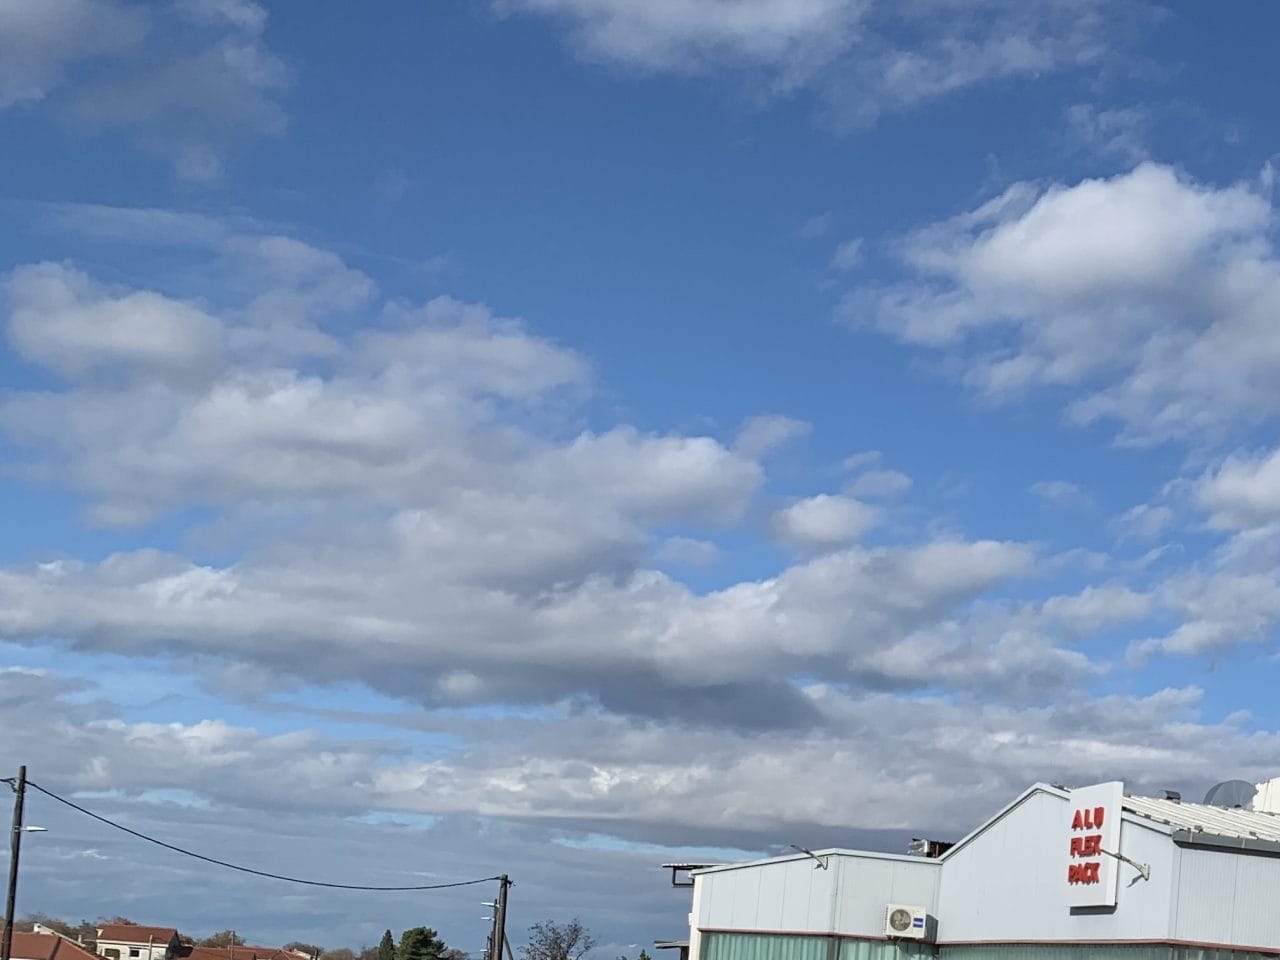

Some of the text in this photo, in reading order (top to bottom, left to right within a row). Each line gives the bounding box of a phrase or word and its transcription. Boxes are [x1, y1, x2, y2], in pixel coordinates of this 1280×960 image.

[1071, 807, 1104, 831] ALU
[1070, 835, 1102, 858] FLEX
[1068, 863, 1100, 885] PACK
